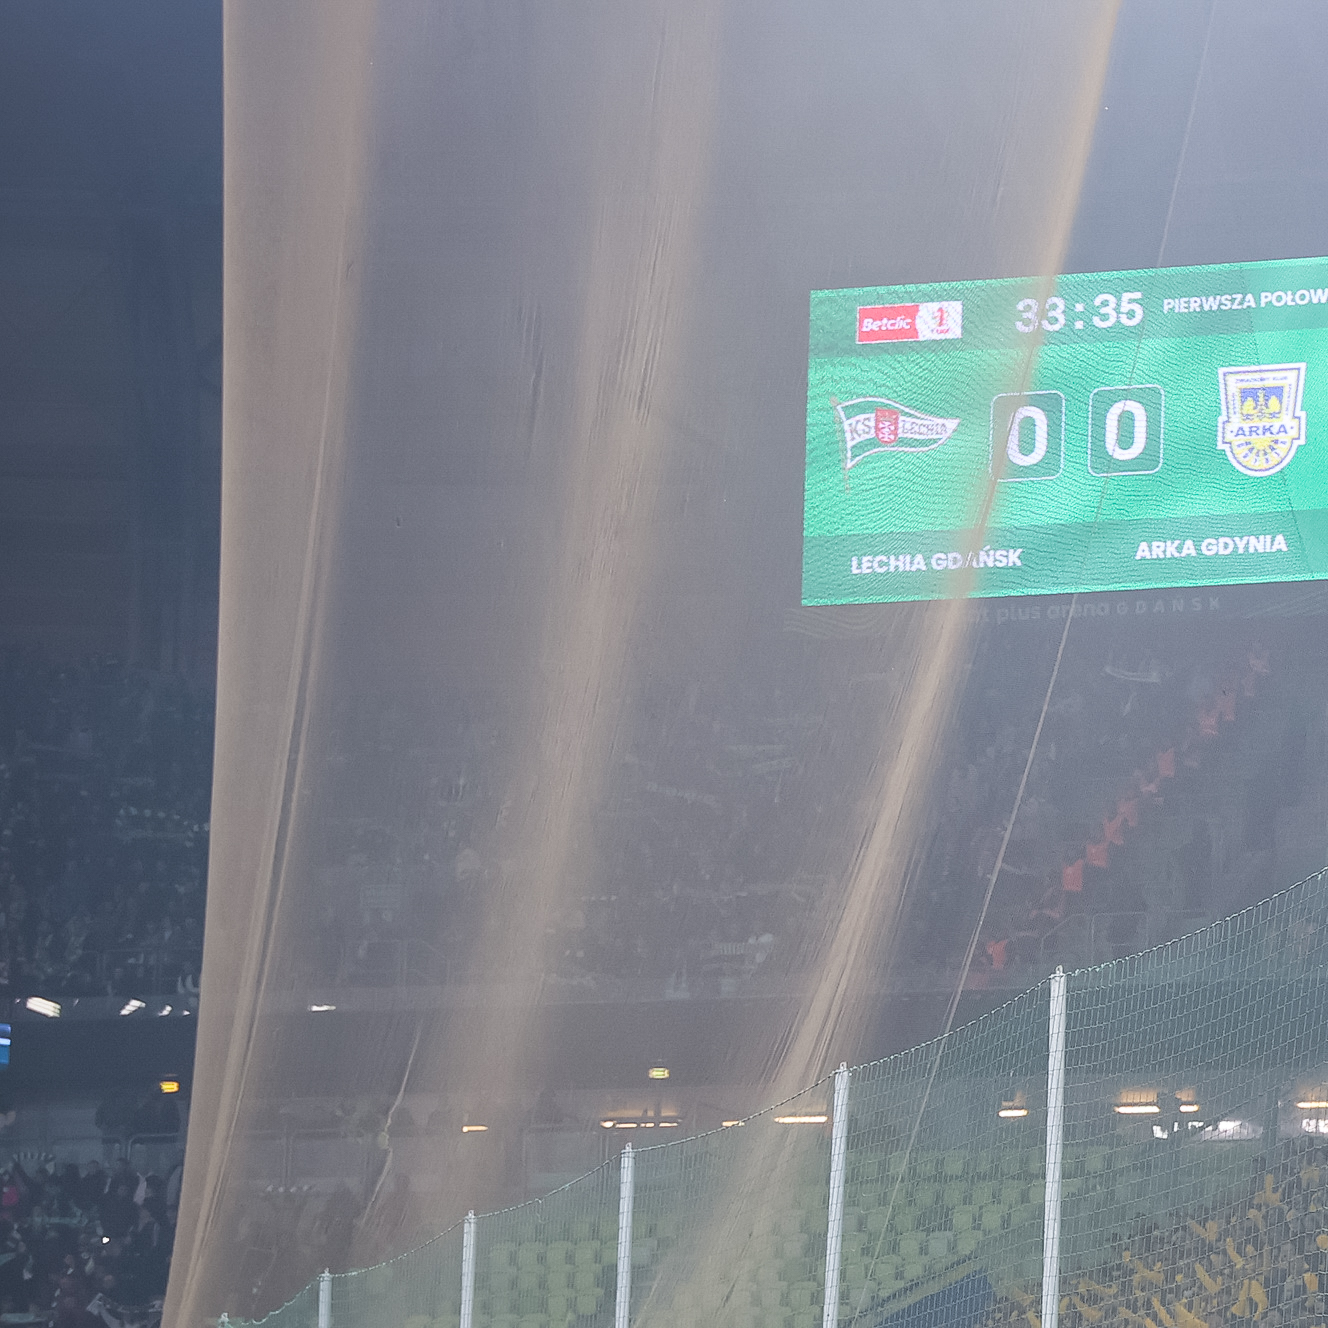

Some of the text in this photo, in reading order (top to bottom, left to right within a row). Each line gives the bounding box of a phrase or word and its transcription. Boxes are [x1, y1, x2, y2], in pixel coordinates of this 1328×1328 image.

[1015, 292, 1144, 334] 33:35
[1163, 295, 1256, 315] PIERWSZA
[860, 314, 912, 333] Betclic
[1006, 405, 1049, 467] 0
[1105, 399, 1148, 461] 0
[1235, 424, 1289, 437] ARKA
[1135, 533, 1288, 561] ARKA GDYNIA
[850, 553, 927, 575] LECHIA
